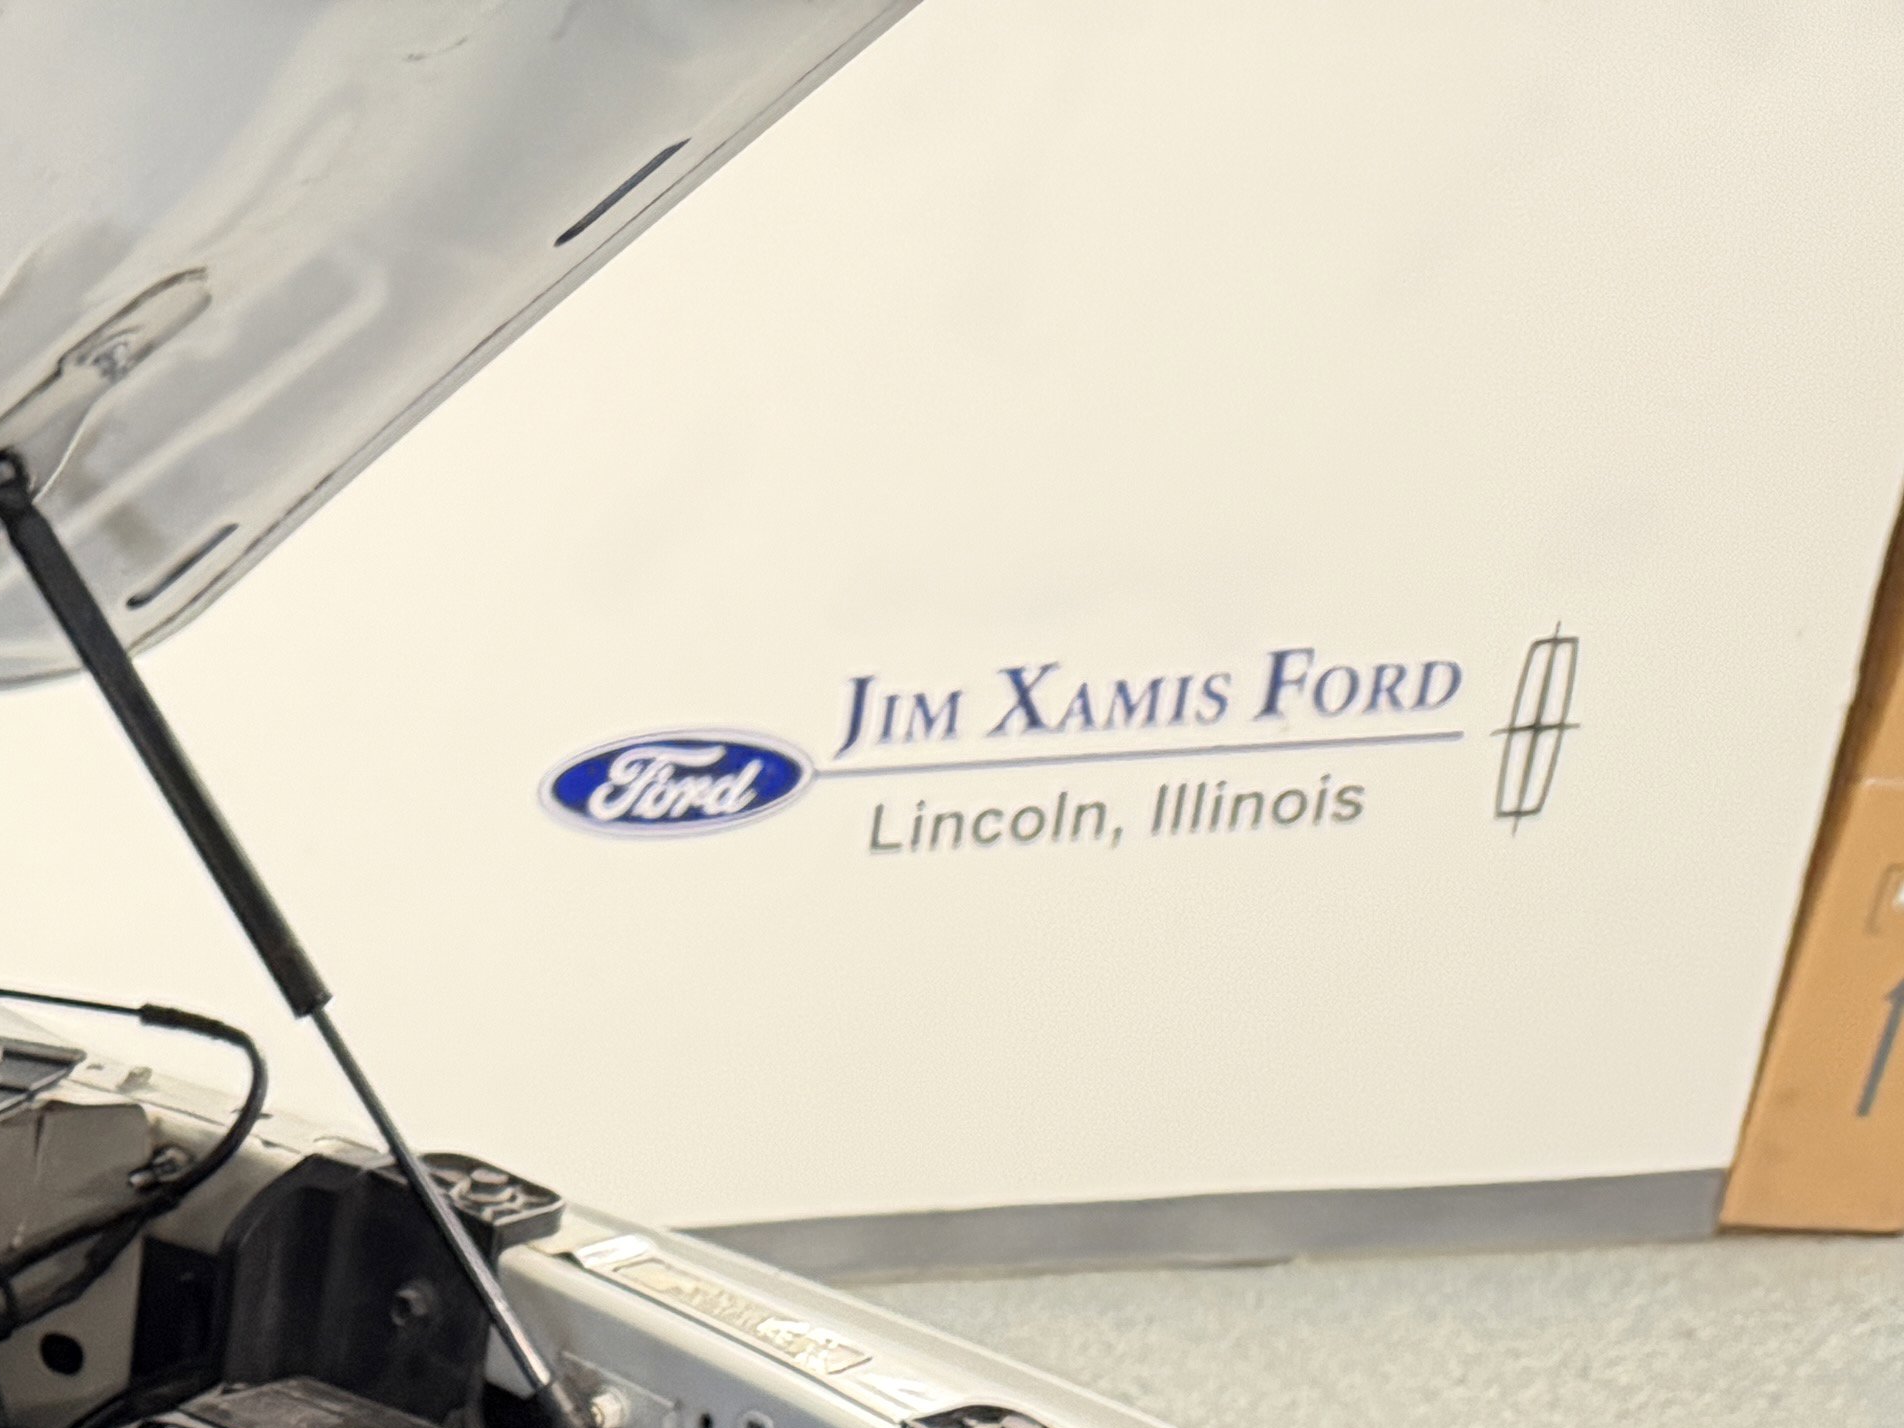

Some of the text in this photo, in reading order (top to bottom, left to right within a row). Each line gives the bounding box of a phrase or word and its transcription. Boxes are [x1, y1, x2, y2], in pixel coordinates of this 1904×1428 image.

[834, 646, 1462, 759] JIM XAMIS FORD
[588, 741, 766, 823] Ford
[868, 775, 1368, 855] Lincoln, Illinois
